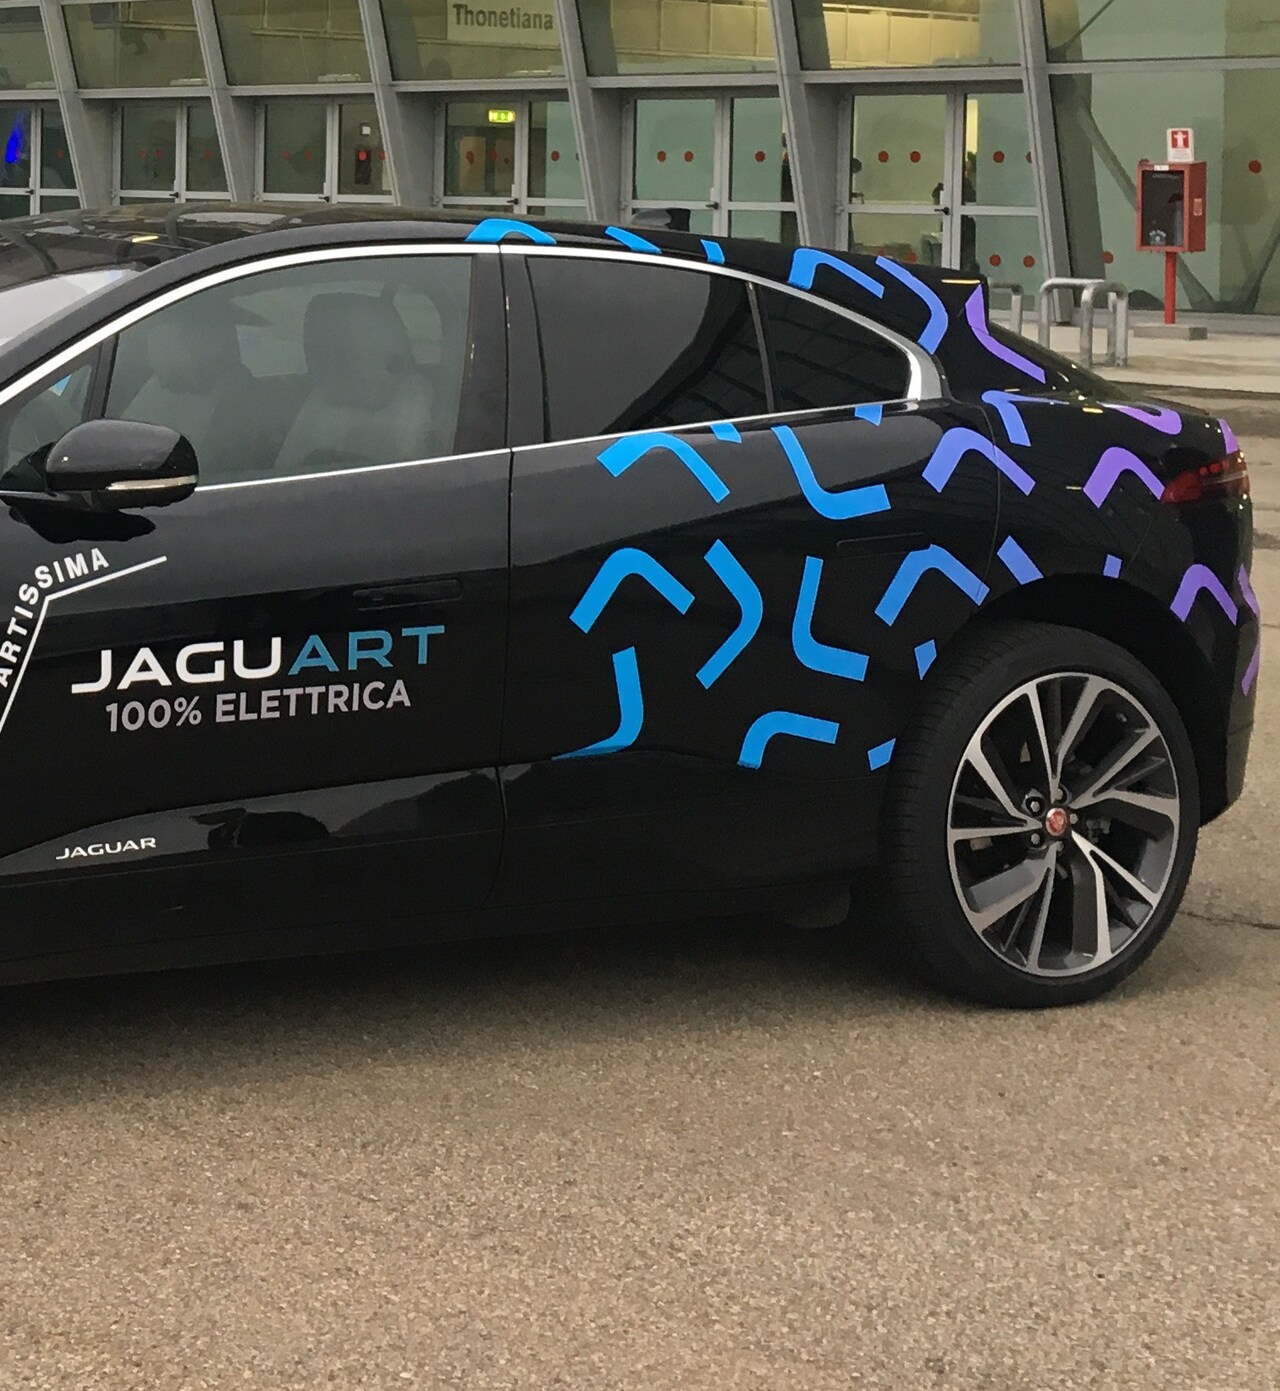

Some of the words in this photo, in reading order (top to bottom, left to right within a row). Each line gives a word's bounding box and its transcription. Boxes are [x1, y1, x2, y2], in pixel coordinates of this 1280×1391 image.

[452, 3, 554, 30] Thonetiana
[71, 624, 445, 694] JAGUART
[106, 696, 202, 733] 100%
[215, 679, 412, 724] ELETTRICA
[55, 836, 157, 860] JAGUAR
